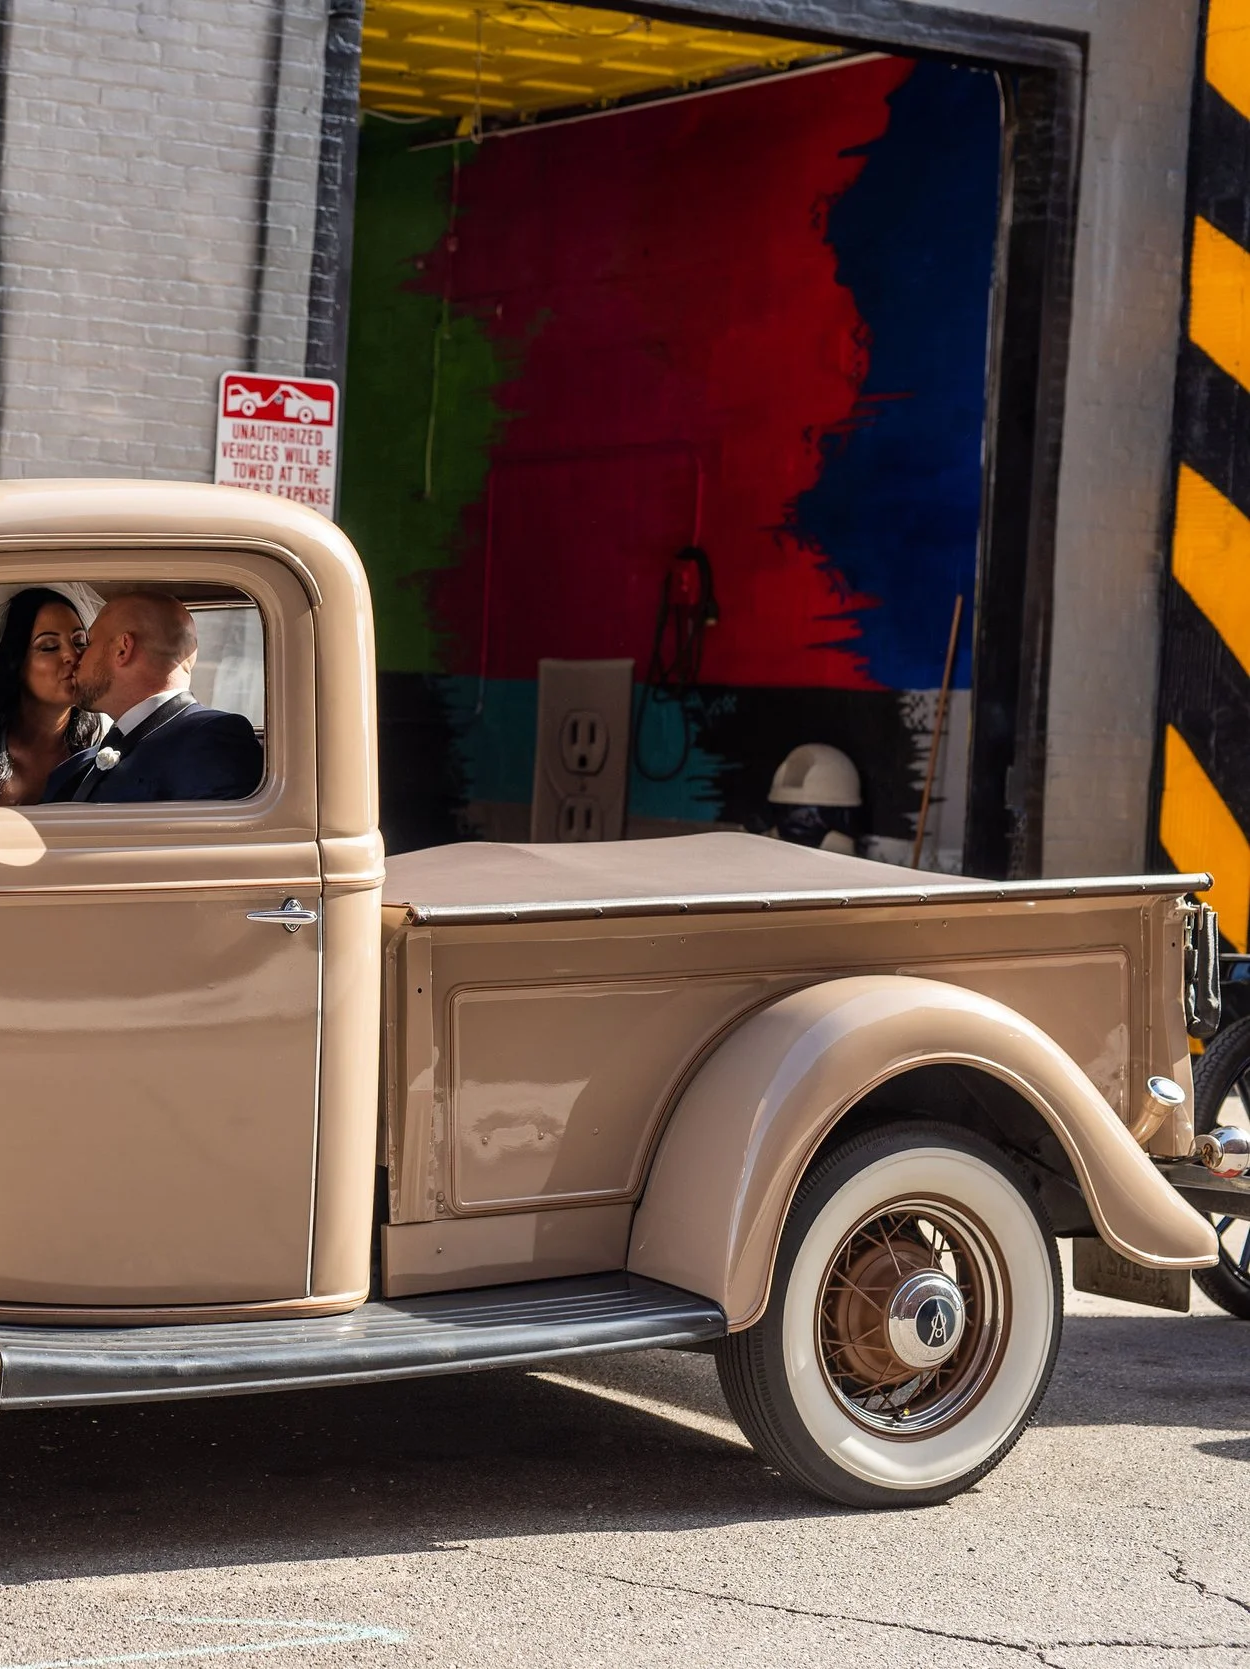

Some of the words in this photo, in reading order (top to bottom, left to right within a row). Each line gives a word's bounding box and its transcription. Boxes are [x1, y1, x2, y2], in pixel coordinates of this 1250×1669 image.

[232, 423, 323, 446] UNAUTHORIZED
[221, 442, 279, 462] VEHICLES
[284, 446, 312, 465] WILL
[317, 449, 332, 467] BE
[232, 462, 274, 481] TOWED
[279, 466, 293, 482] AT
[298, 467, 319, 485] THE
[277, 485, 332, 505] EXPENSE
